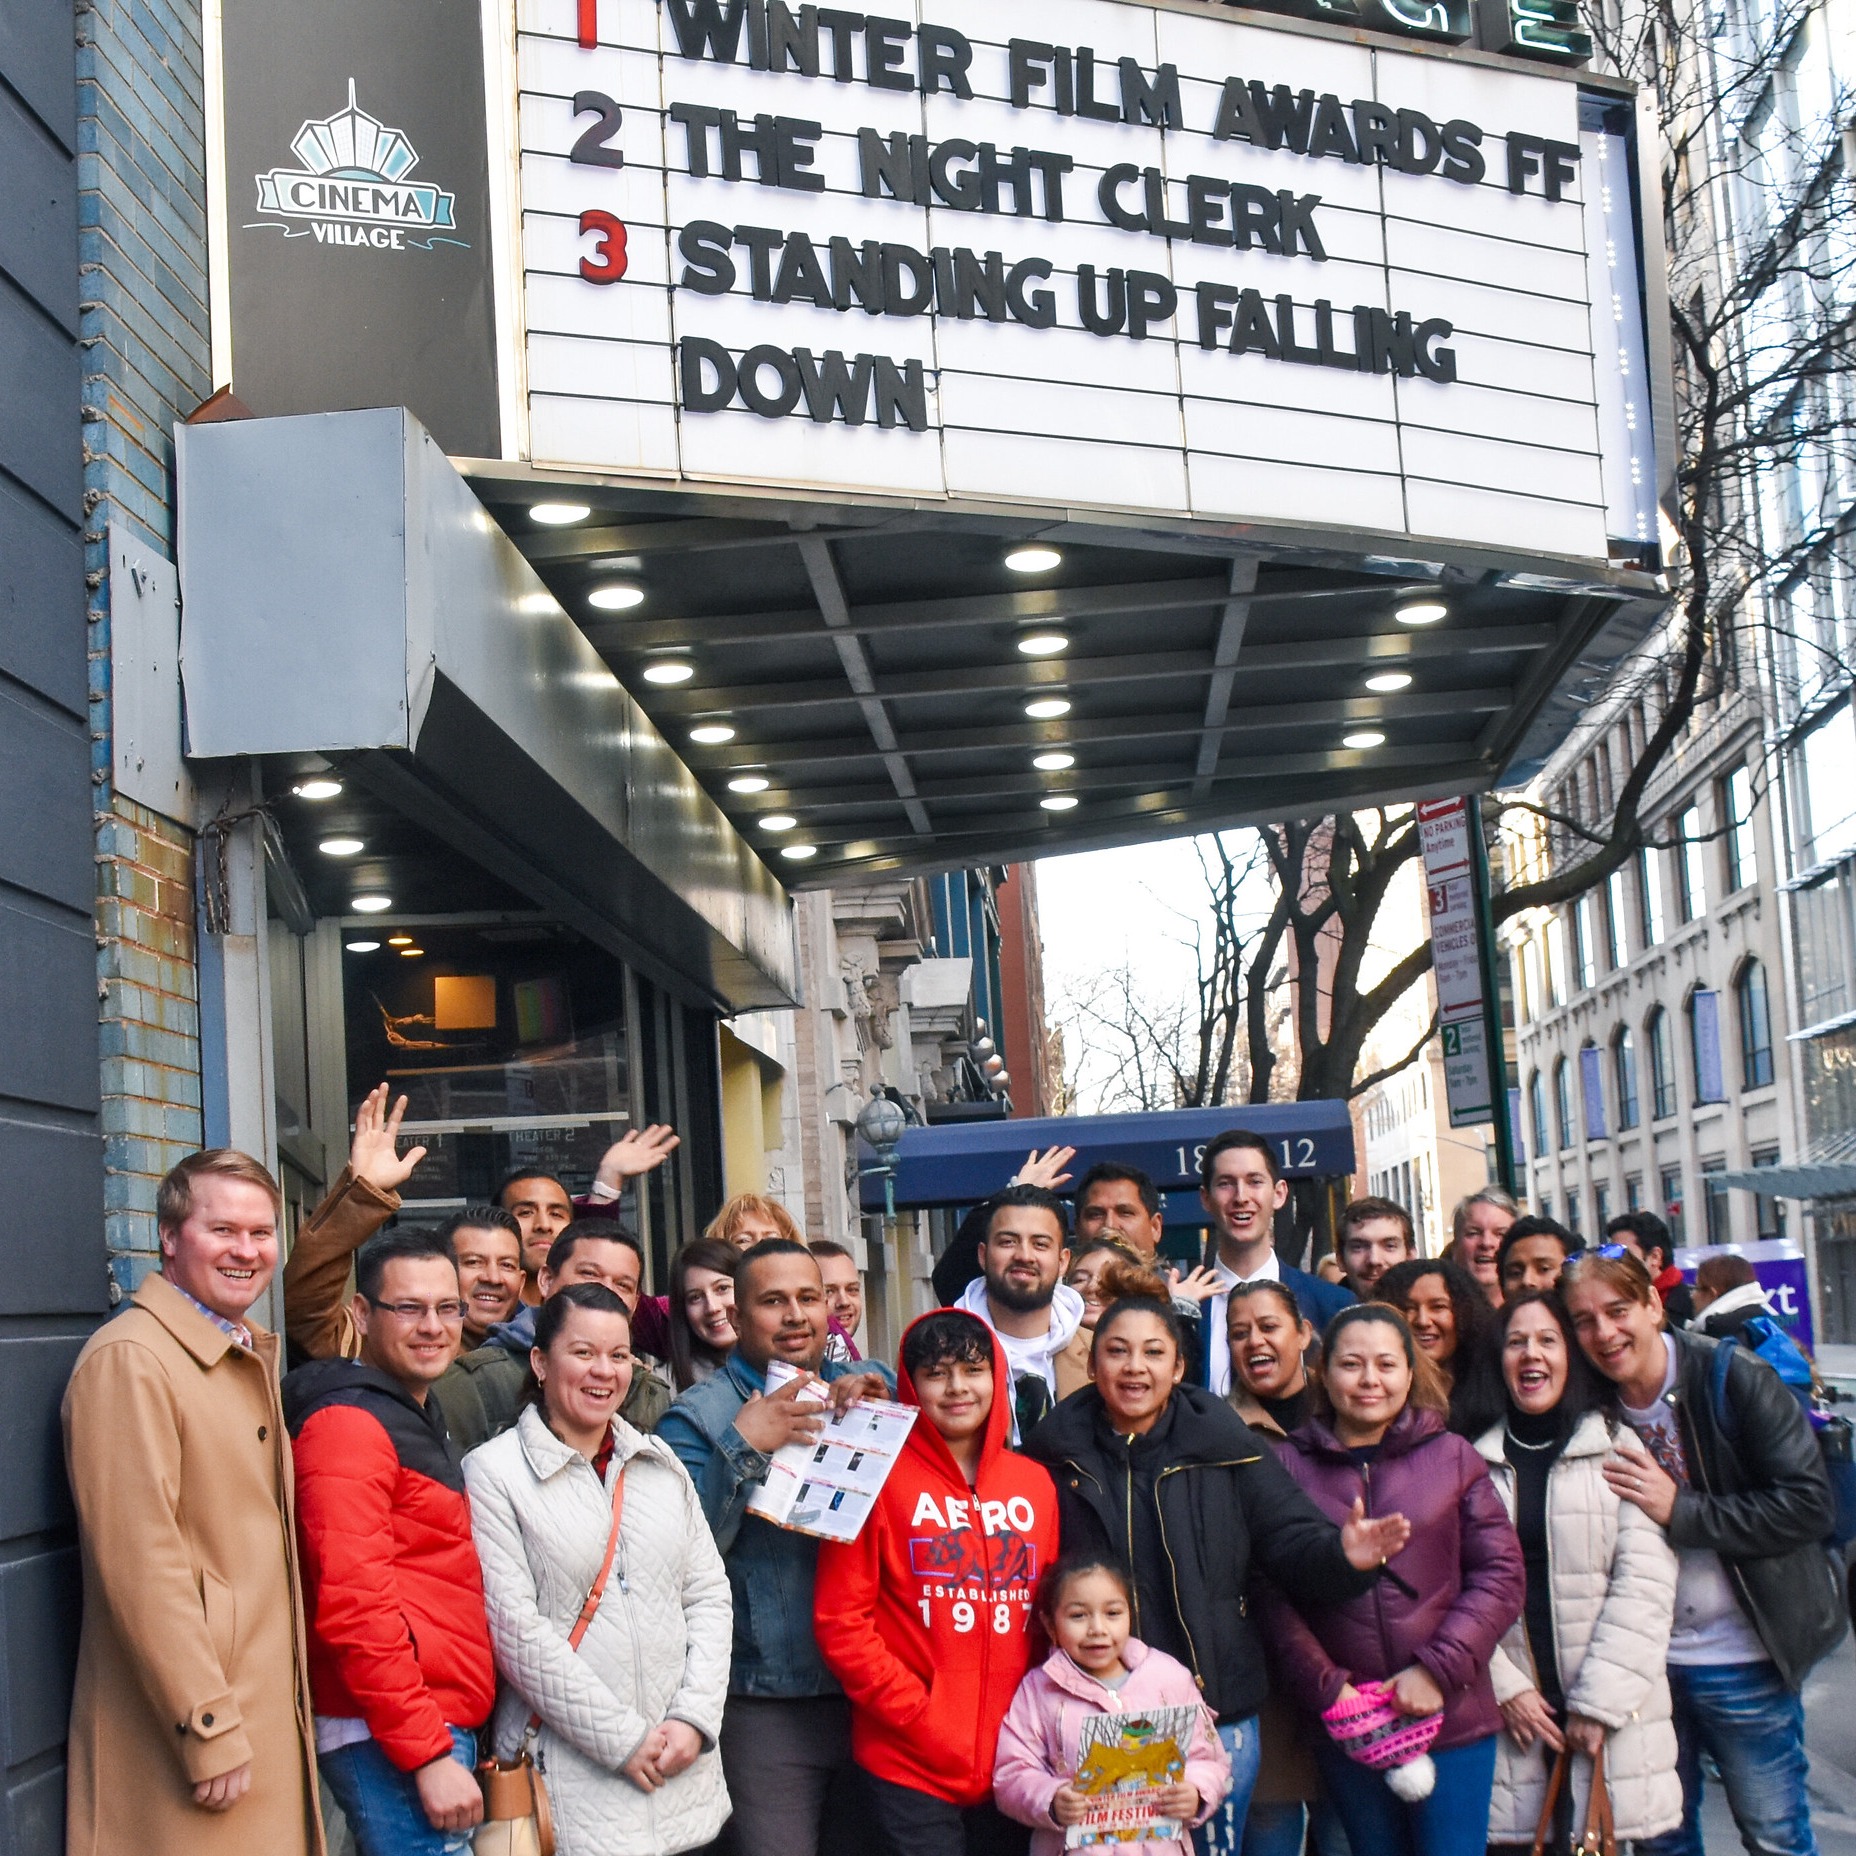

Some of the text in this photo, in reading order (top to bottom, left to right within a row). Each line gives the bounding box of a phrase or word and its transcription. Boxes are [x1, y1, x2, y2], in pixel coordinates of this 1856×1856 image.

[575, 0, 1581, 202] 1 WINTER FILM AWARDS FF
[570, 90, 1328, 262] 2 THE NIGHT CLERK
[290, 181, 423, 219] CINEMA
[310, 222, 405, 250] VILLAGE
[578, 209, 1457, 385] 3 STANDING UP FALLING
[680, 335, 928, 433] DOWN
[1424, 815, 1467, 838] NO PARKING
[1426, 838, 1455, 854] Anytime
[1434, 888, 1444, 912] 3
[1446, 1028, 1457, 1055] 2
[395, 1135, 430, 1148] EATER
[509, 1127, 575, 1142] THEATER 2
[1280, 1138, 1317, 1169] 12
[911, 1492, 1035, 1536] AERO
[923, 1585, 1031, 1603] ESTABLISHED
[1112, 1804, 1158, 1821] FESTIV
